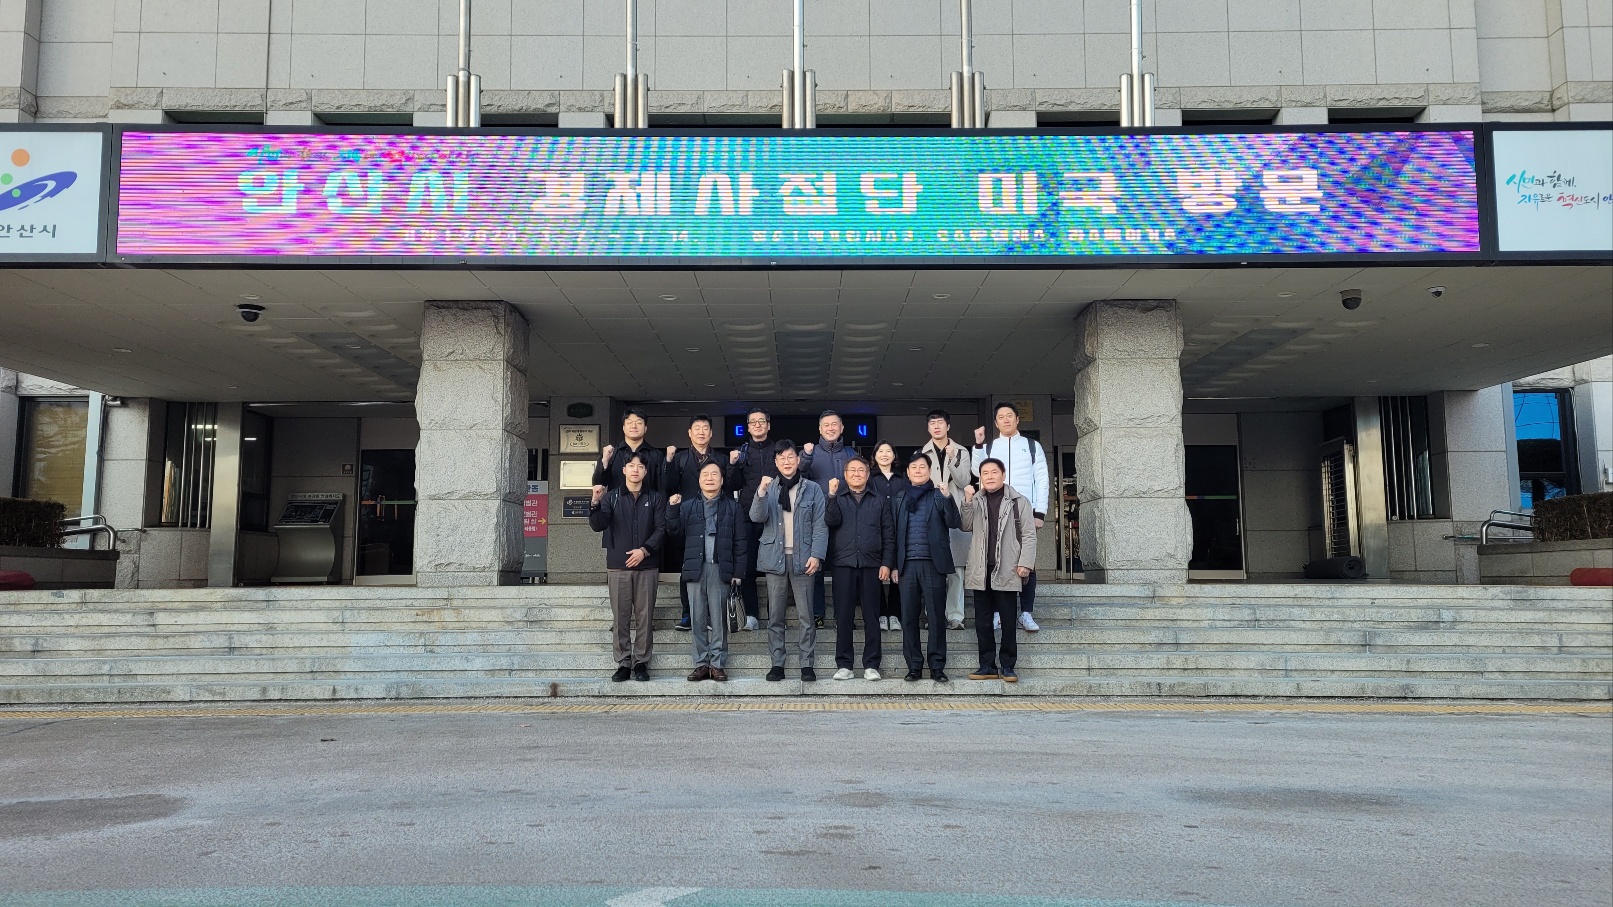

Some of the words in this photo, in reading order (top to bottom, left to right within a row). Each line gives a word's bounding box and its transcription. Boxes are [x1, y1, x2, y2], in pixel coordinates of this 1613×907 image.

[1506, 170, 1547, 193] 시민과
[237, 169, 469, 215] 안산시
[529, 170, 924, 217] 경제사절단
[977, 169, 1123, 215] 미국
[1176, 168, 1324, 214] 방문
[1557, 192, 1600, 210] 혁신도시
[0, 224, 57, 238] 안산시
